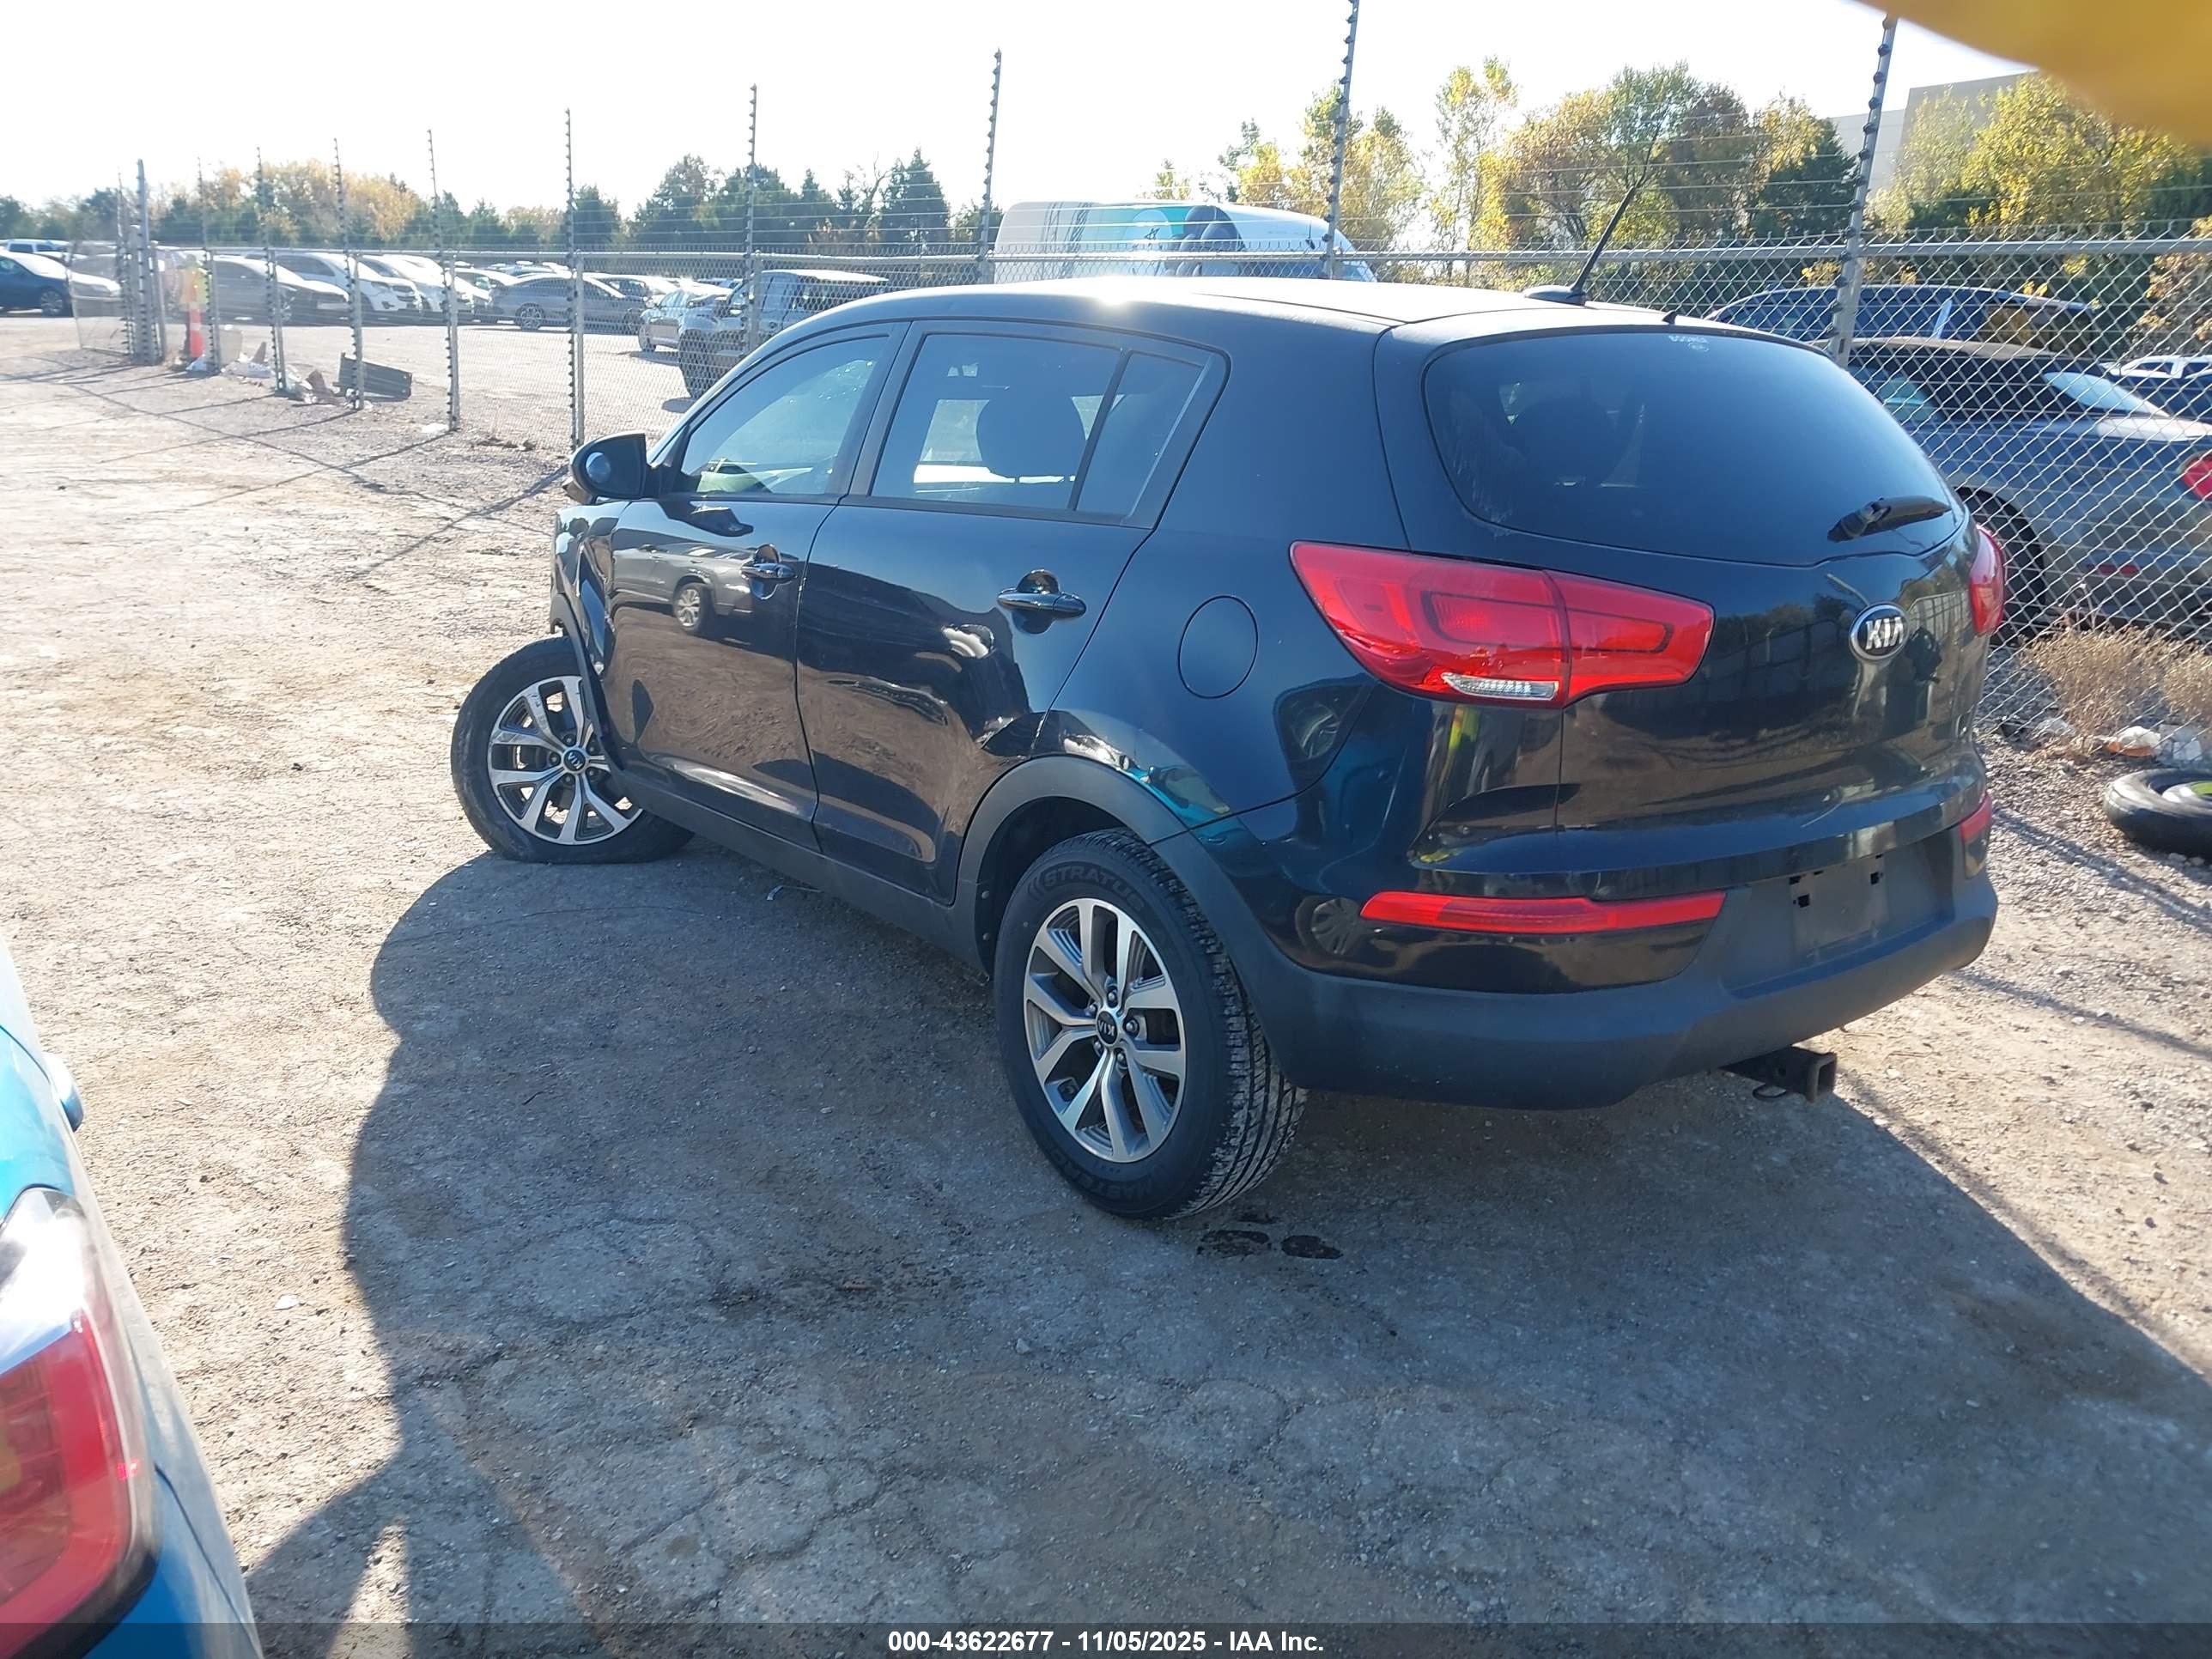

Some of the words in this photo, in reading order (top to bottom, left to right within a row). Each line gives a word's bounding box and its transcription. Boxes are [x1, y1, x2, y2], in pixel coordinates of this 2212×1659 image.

[1865, 616, 1905, 650] KIA
[1042, 865, 1146, 913] STRATUS
[1097, 1019, 1115, 1037] KIA
